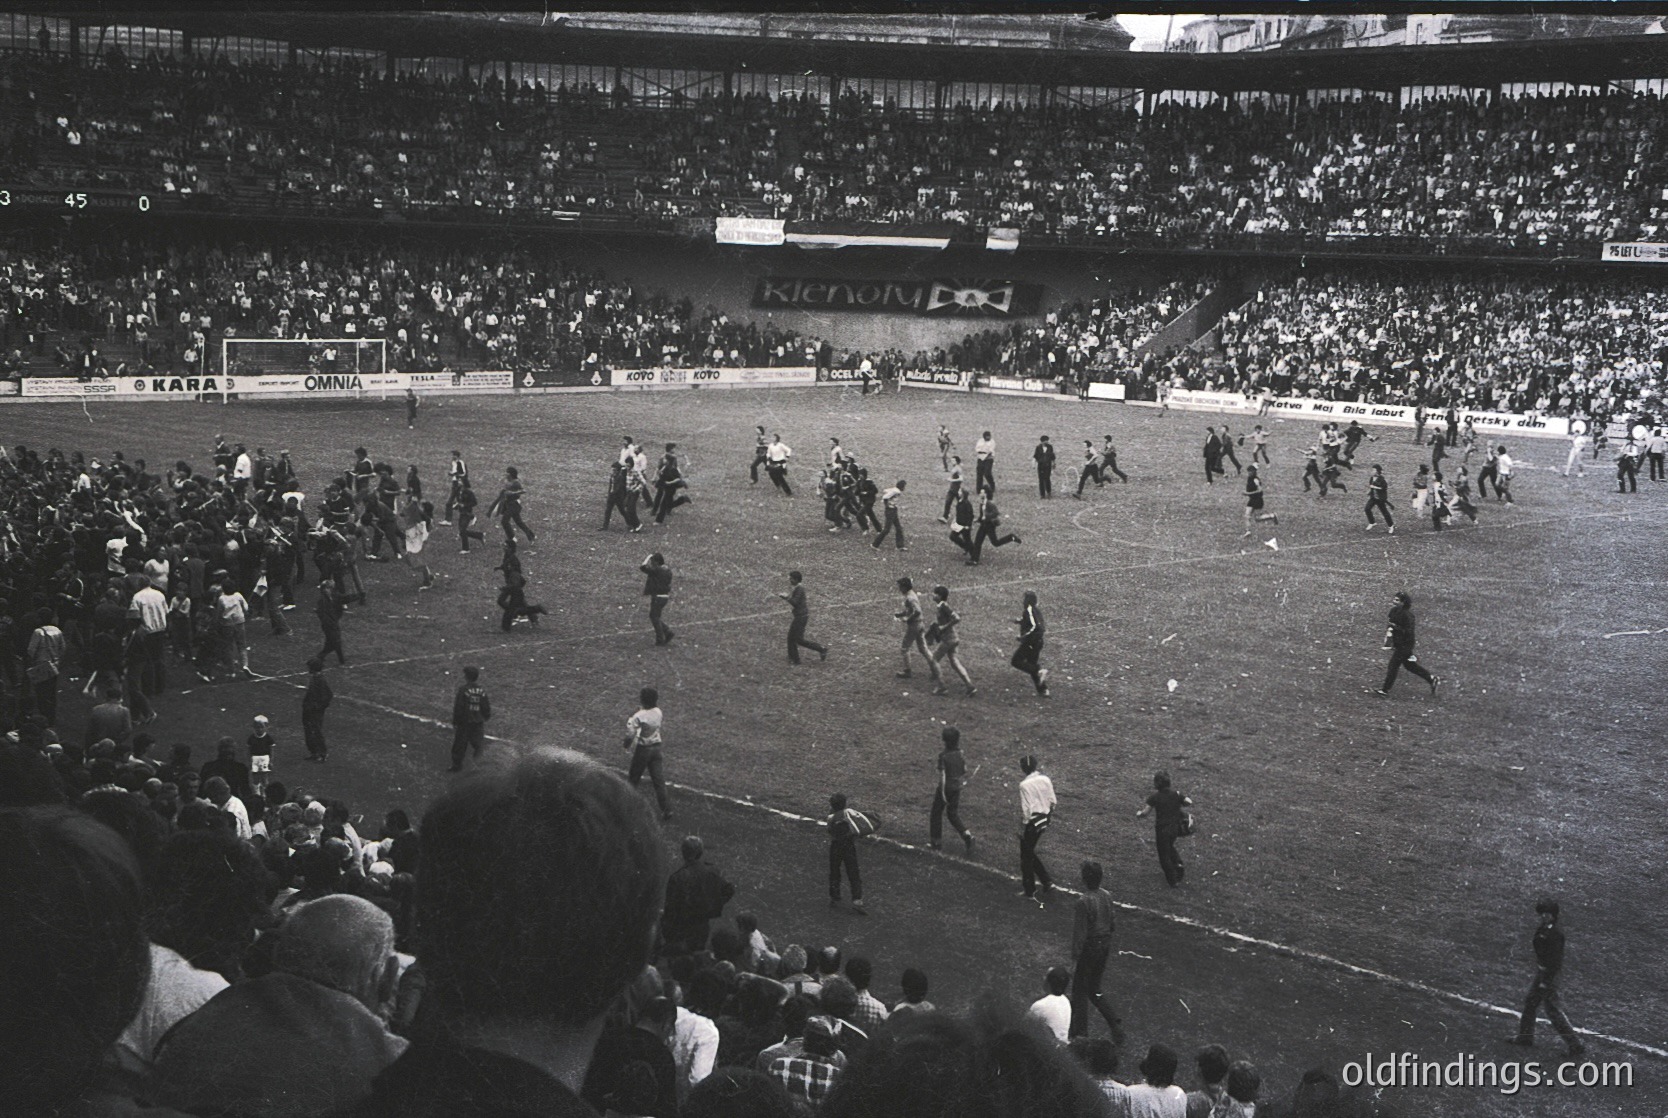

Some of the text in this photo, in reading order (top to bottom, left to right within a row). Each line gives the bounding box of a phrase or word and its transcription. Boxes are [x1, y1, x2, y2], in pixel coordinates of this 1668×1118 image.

[0, 190, 11, 206] 3
[65, 193, 88, 208] 45
[138, 196, 150, 211] 0
[626, 371, 655, 381] KOVO
[693, 370, 720, 380] KOVO
[830, 369, 853, 379] OCEL
[152, 378, 218, 392] KARA
[304, 375, 363, 391] OMNIA
